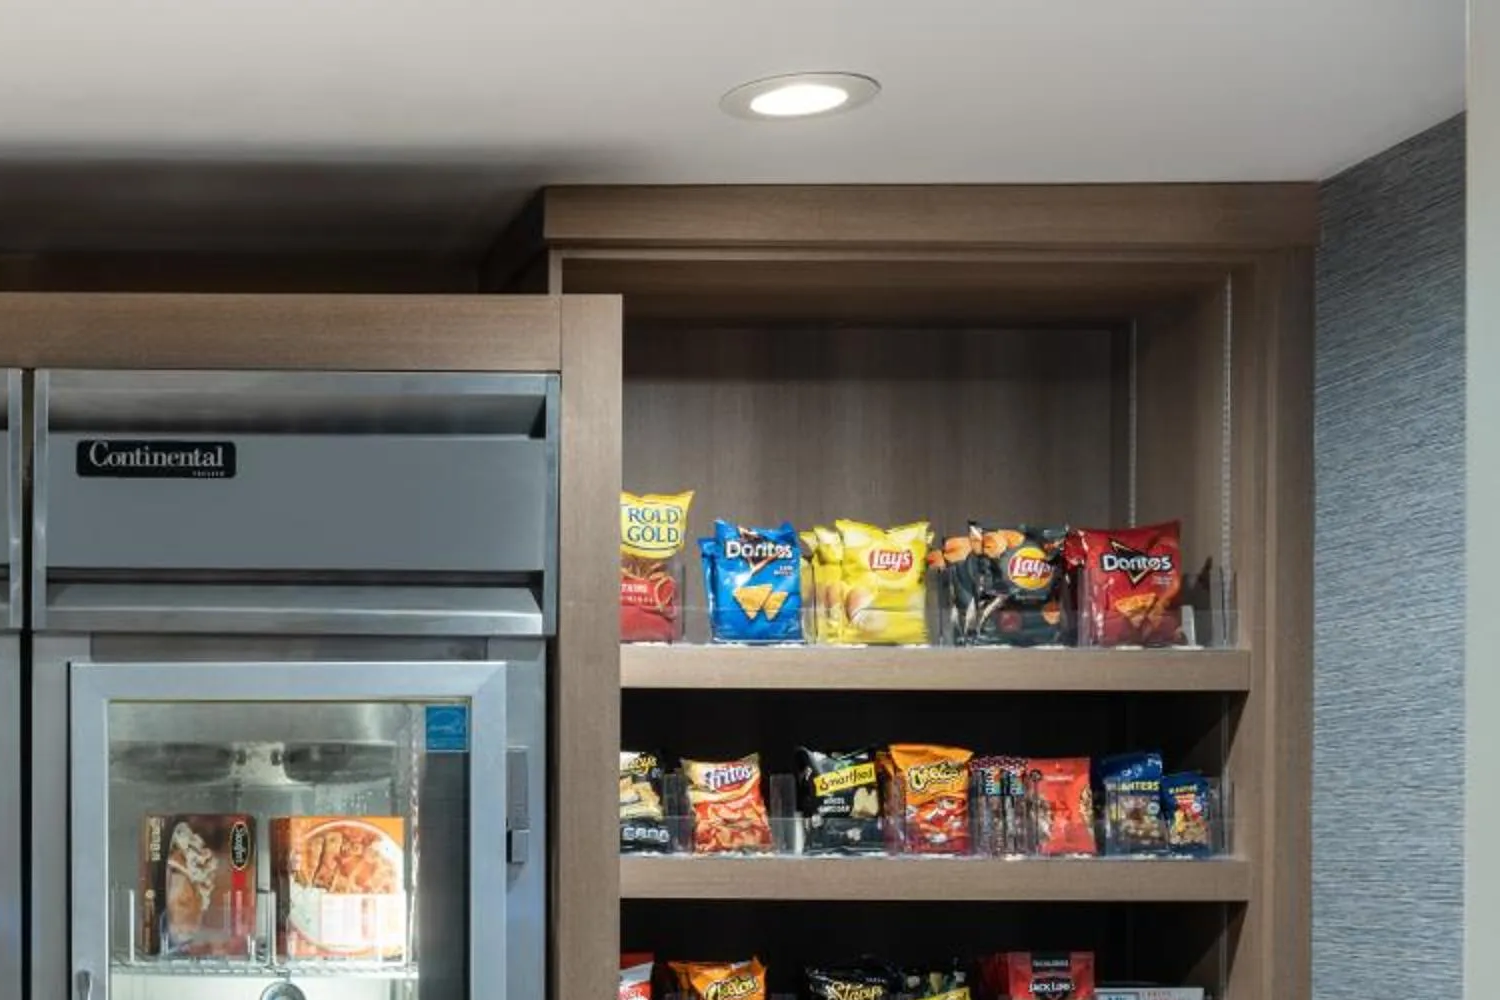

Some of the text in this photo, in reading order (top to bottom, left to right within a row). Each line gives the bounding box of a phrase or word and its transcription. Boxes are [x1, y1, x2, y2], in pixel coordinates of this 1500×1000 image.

[89, 441, 224, 467] Continental
[628, 508, 678, 523] ROLD
[628, 526, 678, 542] GOLD
[726, 541, 792, 559] Doritos
[870, 549, 911, 571] Lay's
[1103, 554, 1172, 572] Doritos
[706, 764, 751, 790] Fritos
[819, 767, 873, 790] Smartfood
